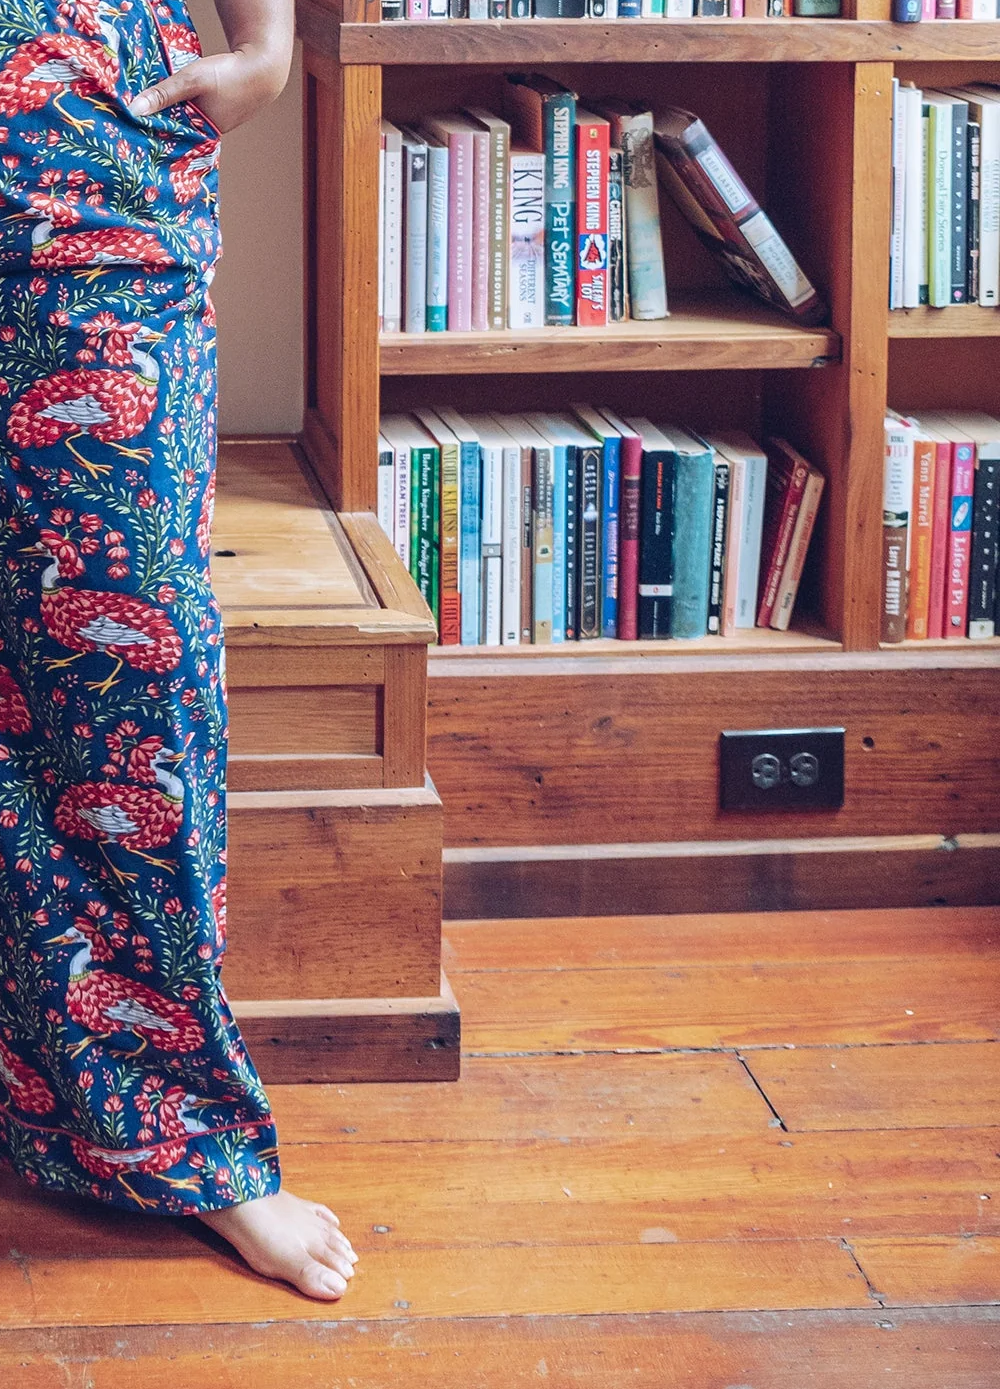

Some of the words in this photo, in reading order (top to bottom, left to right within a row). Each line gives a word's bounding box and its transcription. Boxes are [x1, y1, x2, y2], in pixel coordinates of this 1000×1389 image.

[553, 107, 570, 157] STEPHEN
[553, 158, 570, 189] KING
[585, 149, 601, 199] STEPHEN
[936, 150, 948, 192] Donegal
[512, 168, 543, 224] KING
[936, 193, 947, 217] Fairy
[551, 203, 569, 239] PET
[585, 201, 600, 230] KING
[609, 200, 621, 241] CARRIE
[937, 219, 948, 252] Stories
[519, 263, 528, 302] SEASONS
[527, 260, 536, 304] DIFFERENT
[549, 240, 570, 308] SEMATARY
[581, 282, 592, 301] LOT
[919, 452, 931, 482] Yann
[399, 475, 407, 499] BEAN
[444, 491, 457, 532] KRAUSS
[918, 486, 930, 527] Martel
[953, 537, 965, 567] Life
[443, 552, 457, 590] GREAT
[952, 568, 965, 584] of
[952, 589, 963, 605] Pi
